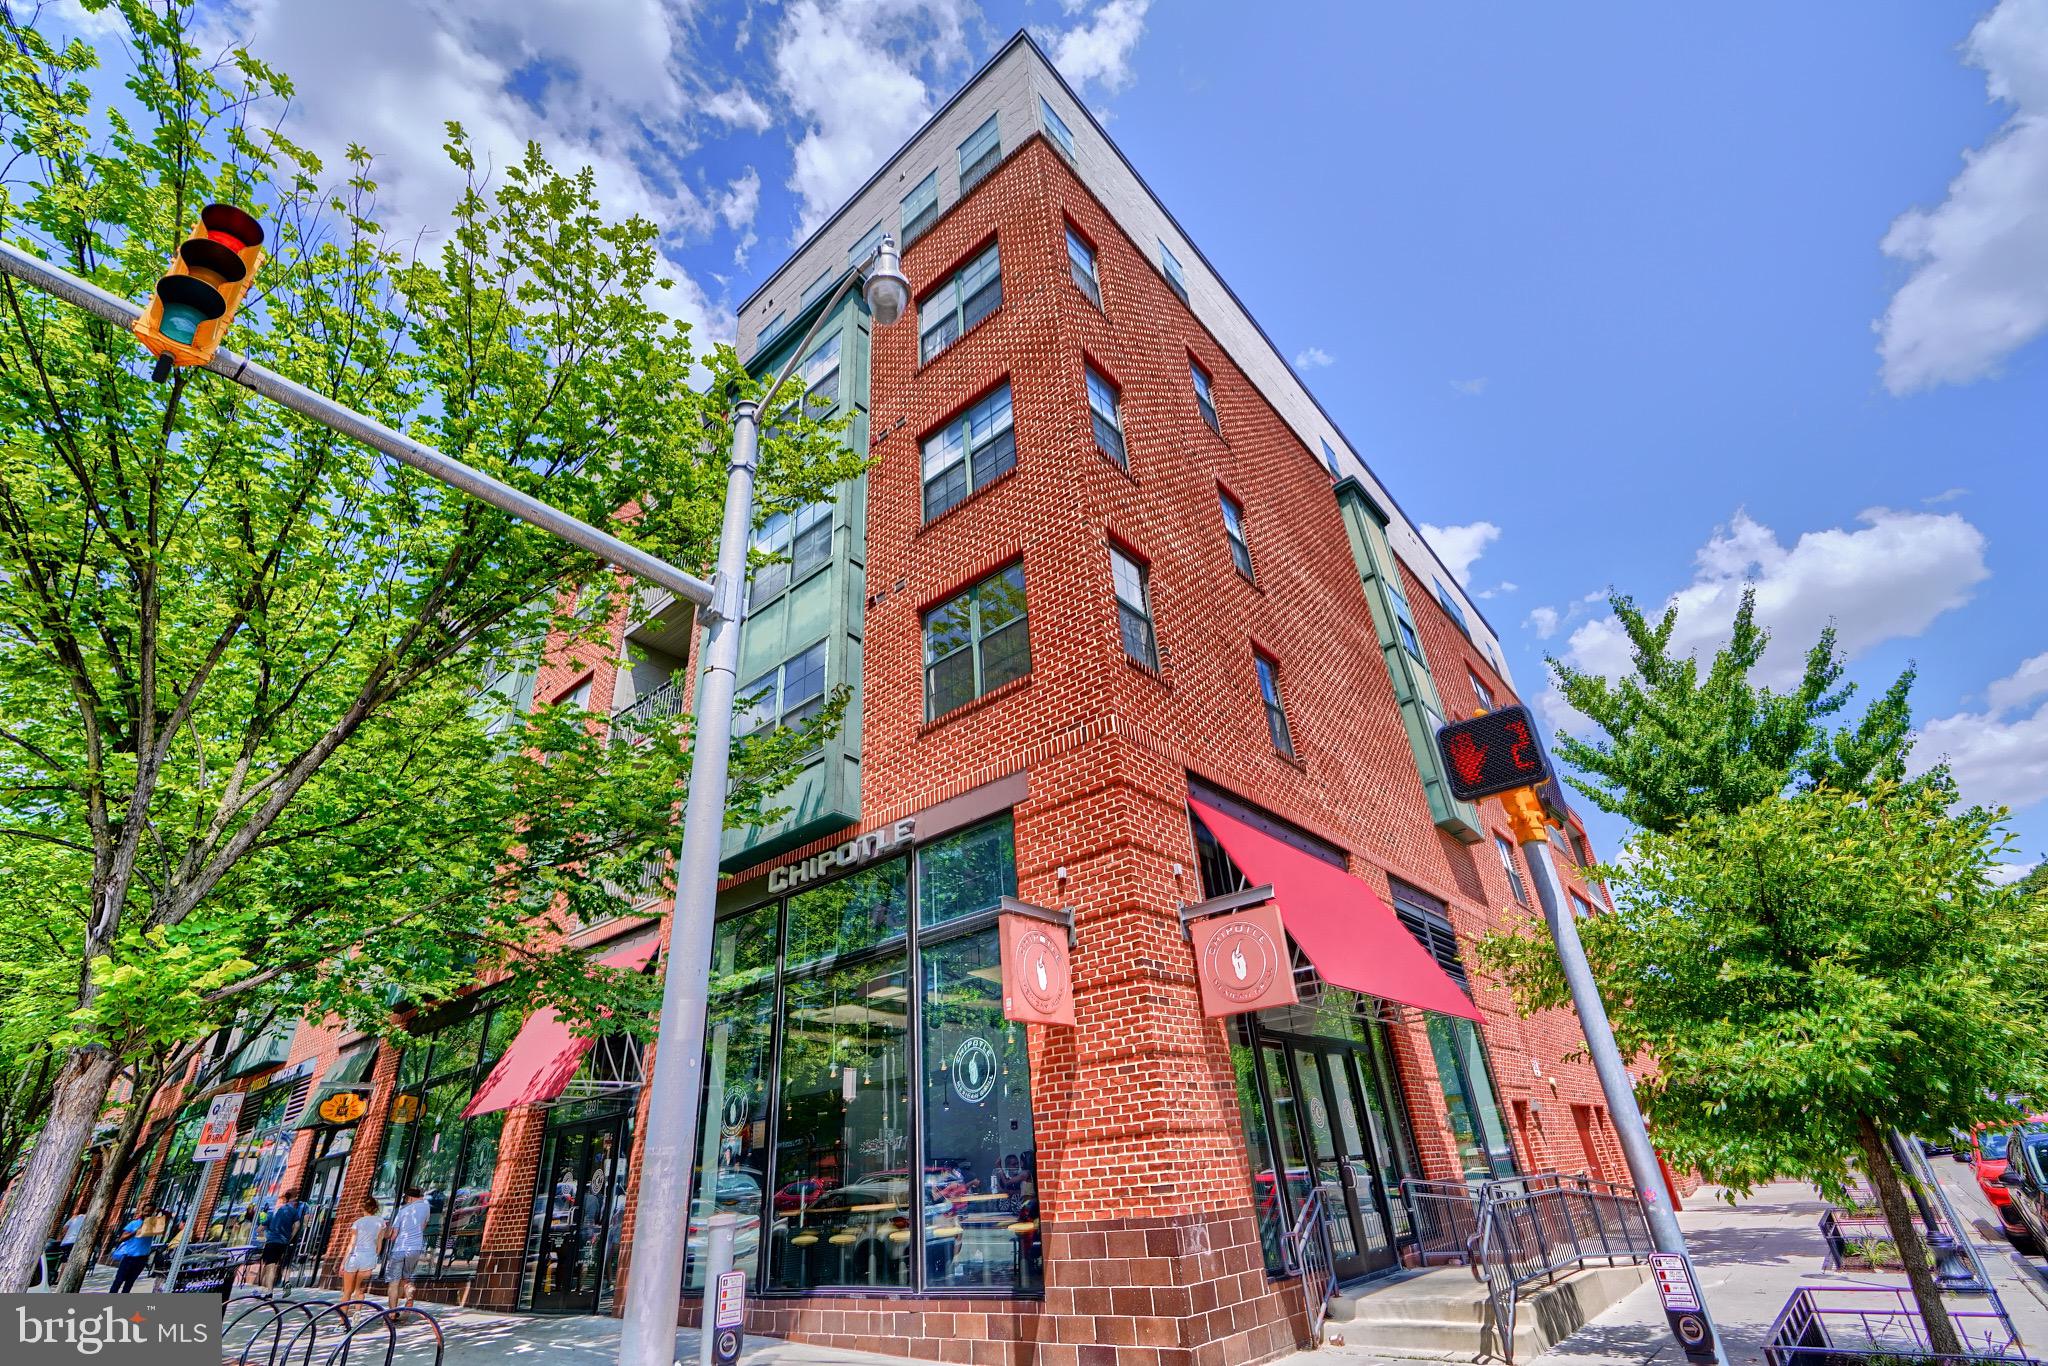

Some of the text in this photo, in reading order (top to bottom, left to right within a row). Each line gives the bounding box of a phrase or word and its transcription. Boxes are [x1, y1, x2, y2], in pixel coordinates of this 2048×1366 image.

[1504, 719, 1535, 771] 2
[767, 817, 916, 894] CHIPOTLE
[1208, 923, 1266, 956] CHIPOTLE
[955, 1039, 994, 1064] CHIPOTLE
